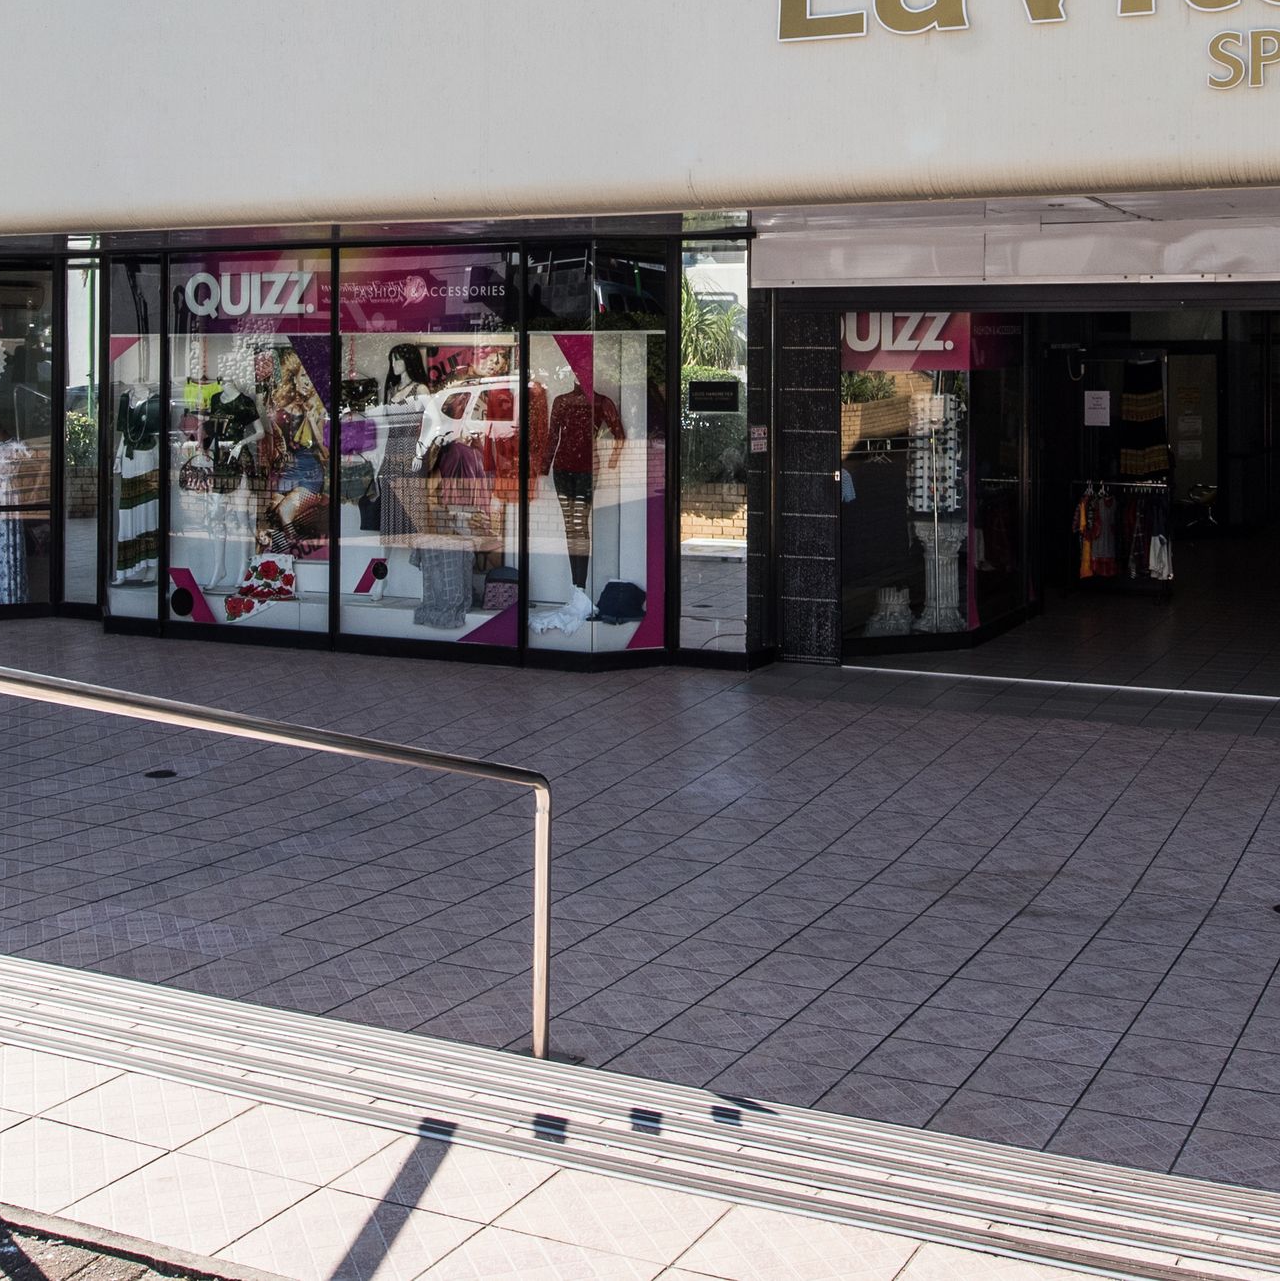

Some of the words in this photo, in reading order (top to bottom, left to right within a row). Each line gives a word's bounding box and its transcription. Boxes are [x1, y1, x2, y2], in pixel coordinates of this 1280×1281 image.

[184, 270, 315, 319] QUIZZ.
[354, 287, 408, 298] FASHION
[410, 287, 418, 297] &
[423, 285, 506, 298] ACCESSORIES
[840, 312, 955, 352] UIZZ.
